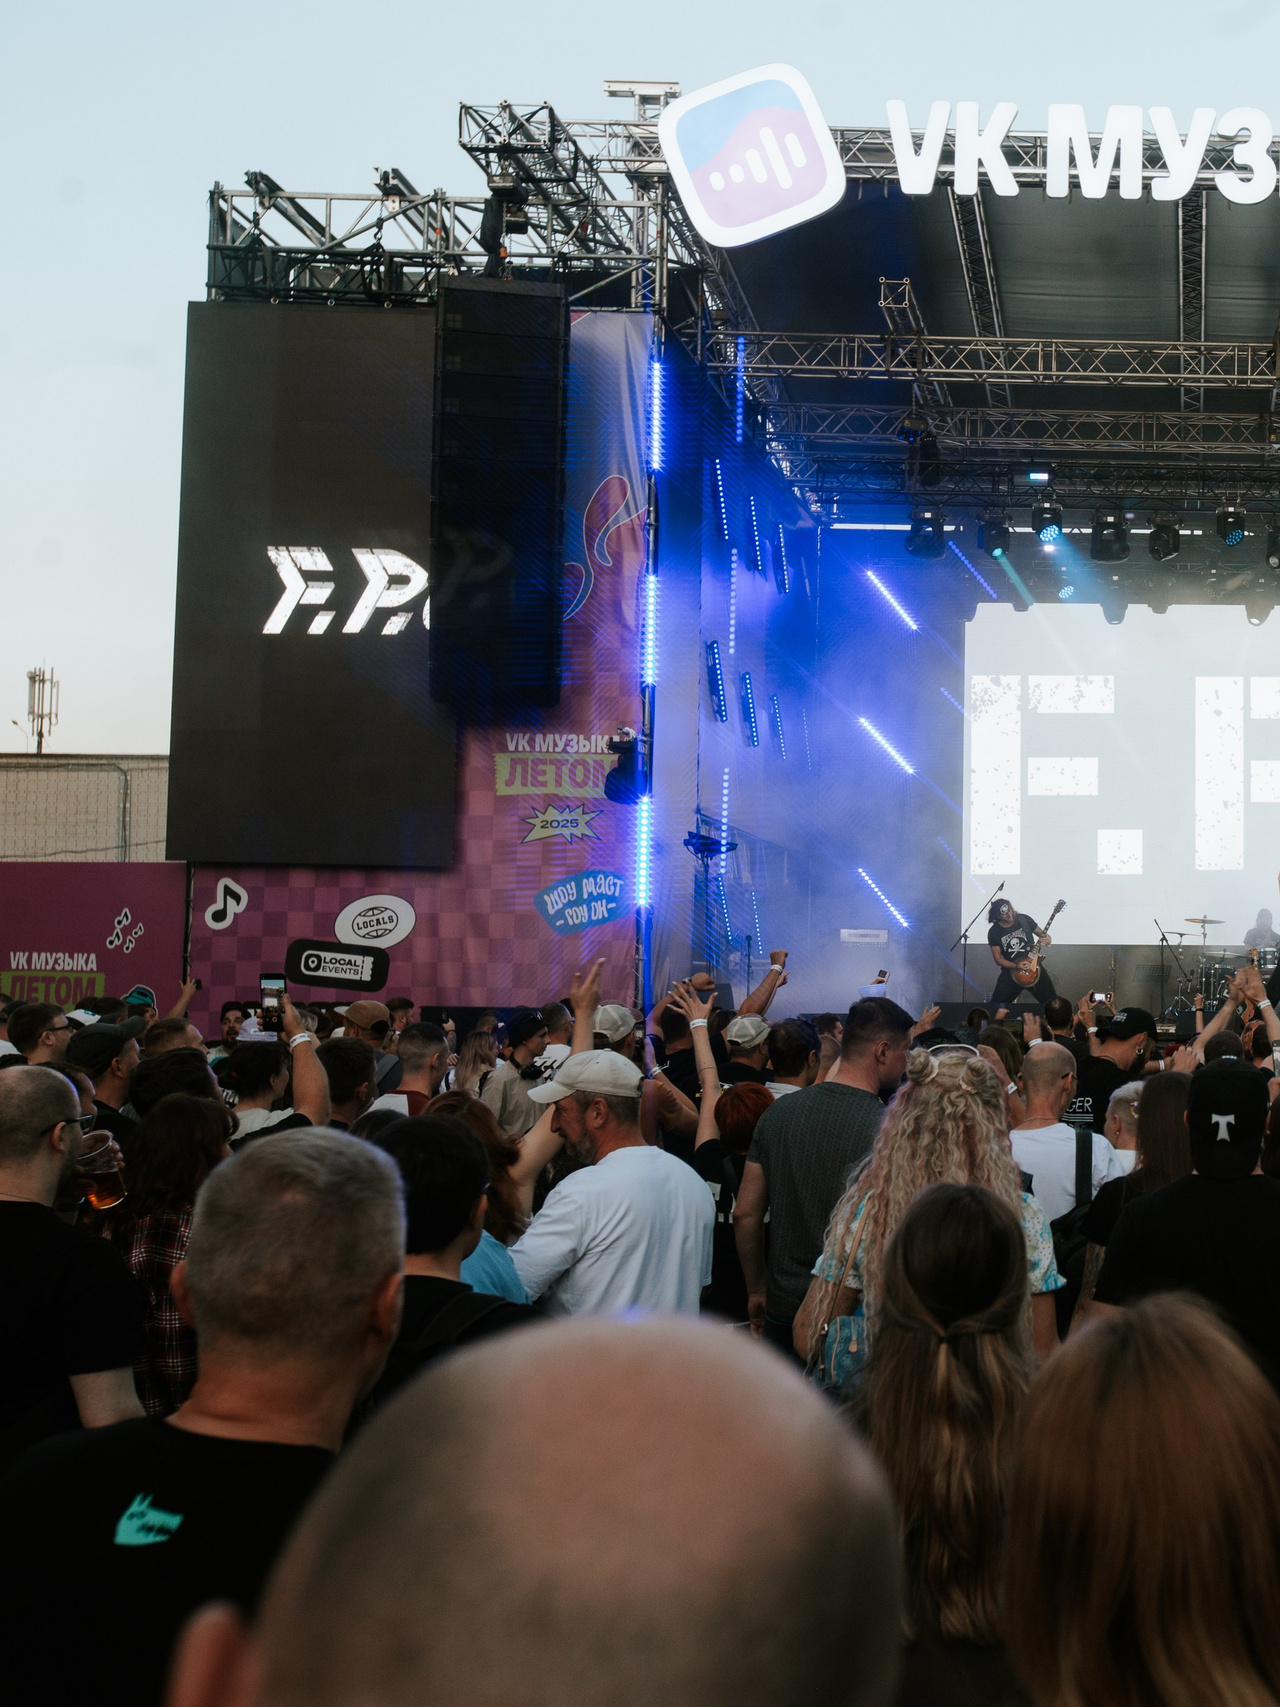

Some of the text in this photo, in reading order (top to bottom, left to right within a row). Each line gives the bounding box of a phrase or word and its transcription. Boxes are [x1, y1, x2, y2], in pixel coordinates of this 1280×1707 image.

[886, 99, 1020, 197] VK
[506, 733, 531, 752] VK
[540, 818, 579, 829] 2025
[543, 881, 577, 915] ШОУ
[356, 915, 394, 931] LOCALS
[10, 951, 98, 972] VK МУЗЫКА
[323, 956, 361, 968] LOCAL
[321, 965, 360, 976] EVENTS
